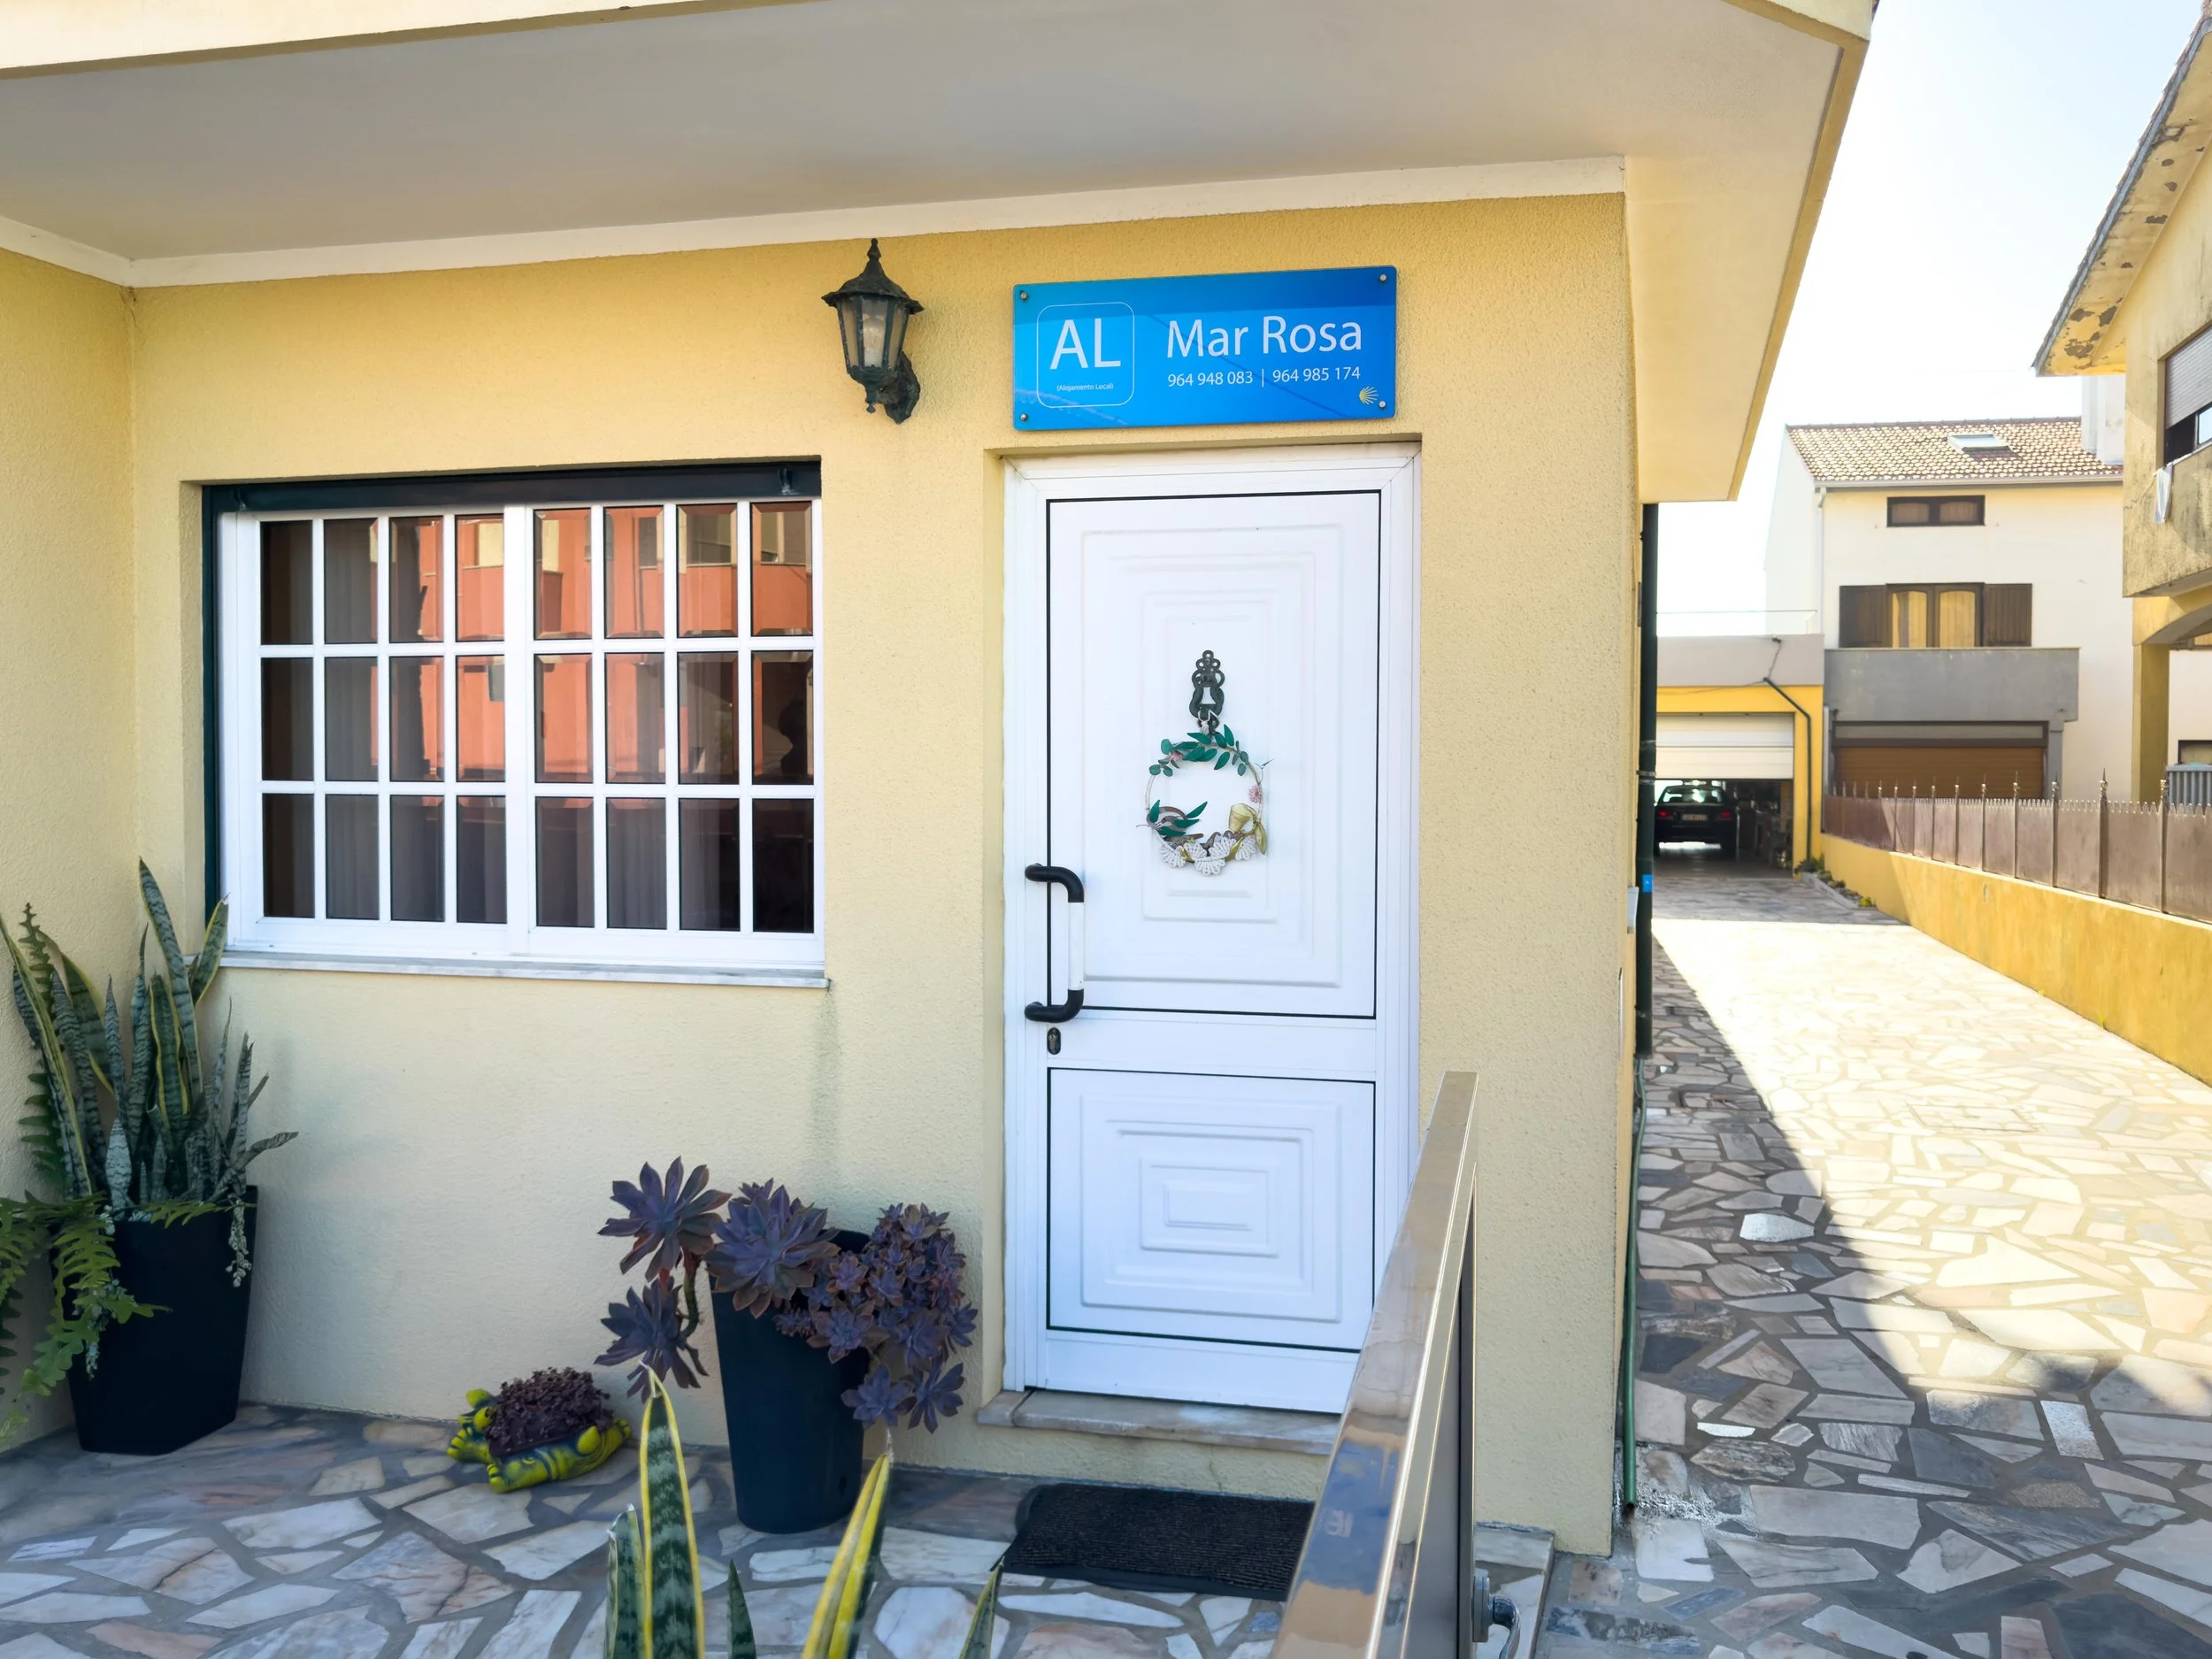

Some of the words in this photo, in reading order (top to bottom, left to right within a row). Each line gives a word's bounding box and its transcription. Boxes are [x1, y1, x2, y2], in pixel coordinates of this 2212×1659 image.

[1049, 318, 1122, 370] AL
[1167, 319, 1248, 358] Mar
[1263, 315, 1362, 354] Rosa
[1168, 373, 1194, 387] 964
[1197, 372, 1224, 386] 948
[1227, 371, 1253, 385] 083
[1272, 369, 1299, 383] 964
[1302, 367, 1329, 381] 985
[1334, 366, 1361, 380] 174
